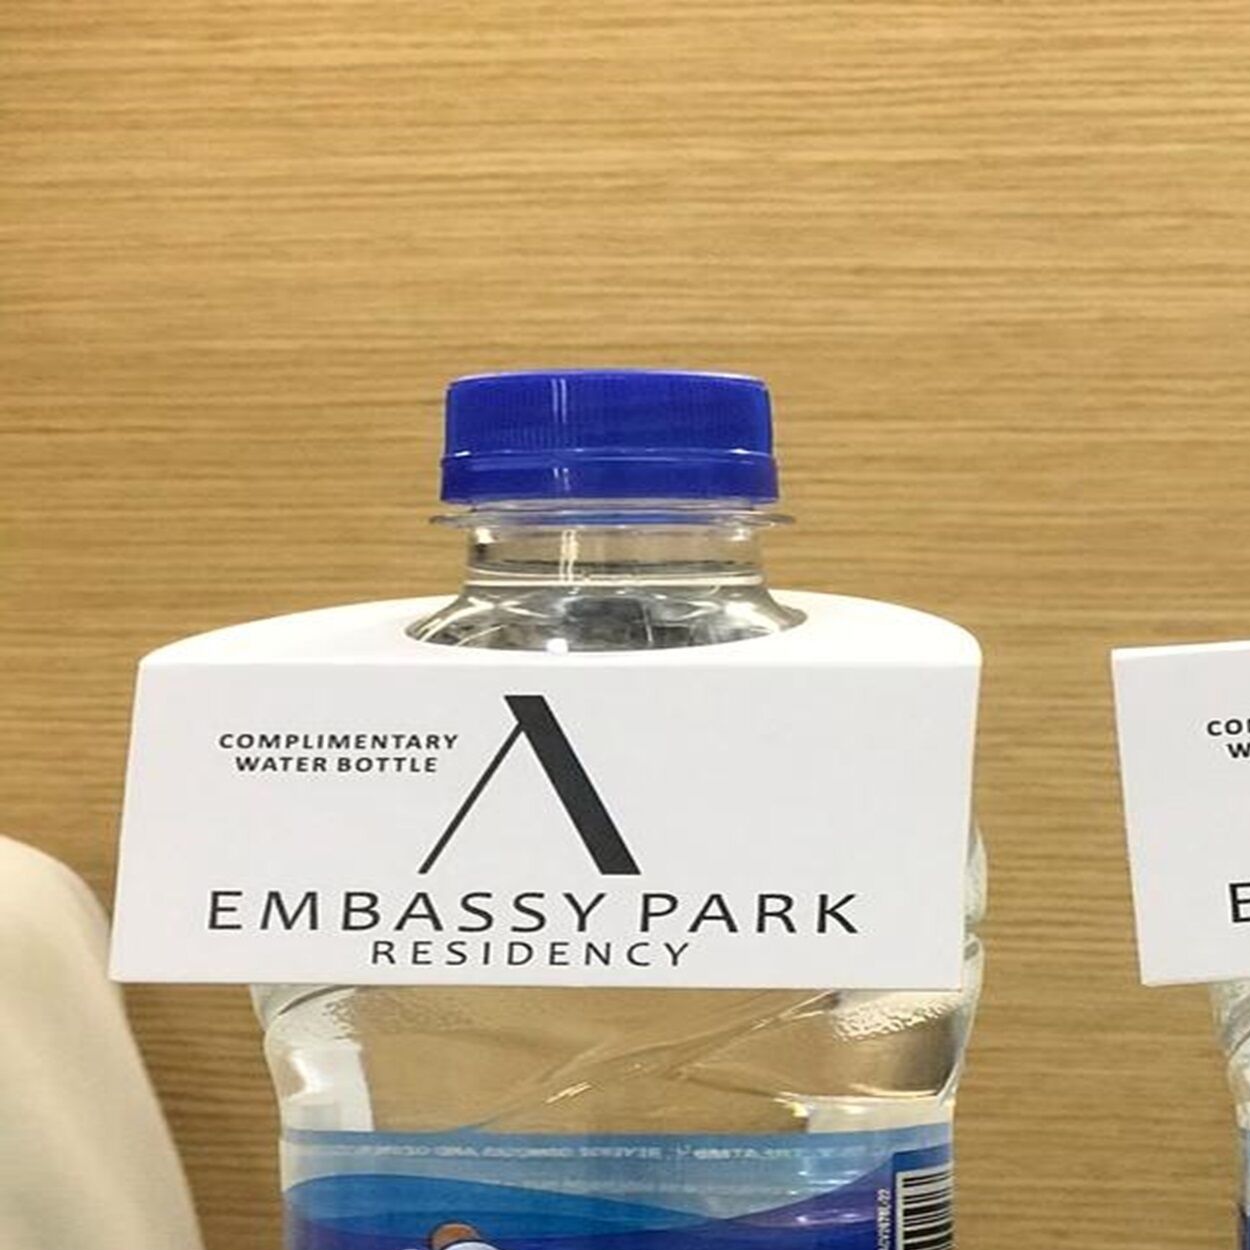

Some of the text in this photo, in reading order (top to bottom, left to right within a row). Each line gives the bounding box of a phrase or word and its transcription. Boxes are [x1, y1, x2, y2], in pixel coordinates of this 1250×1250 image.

[219, 733, 458, 751] COMPLIMENTARY
[235, 756, 438, 773] WATER BOTTLE
[207, 889, 860, 935] EMBASSY PARK
[371, 940, 690, 968] RESIDENCY
